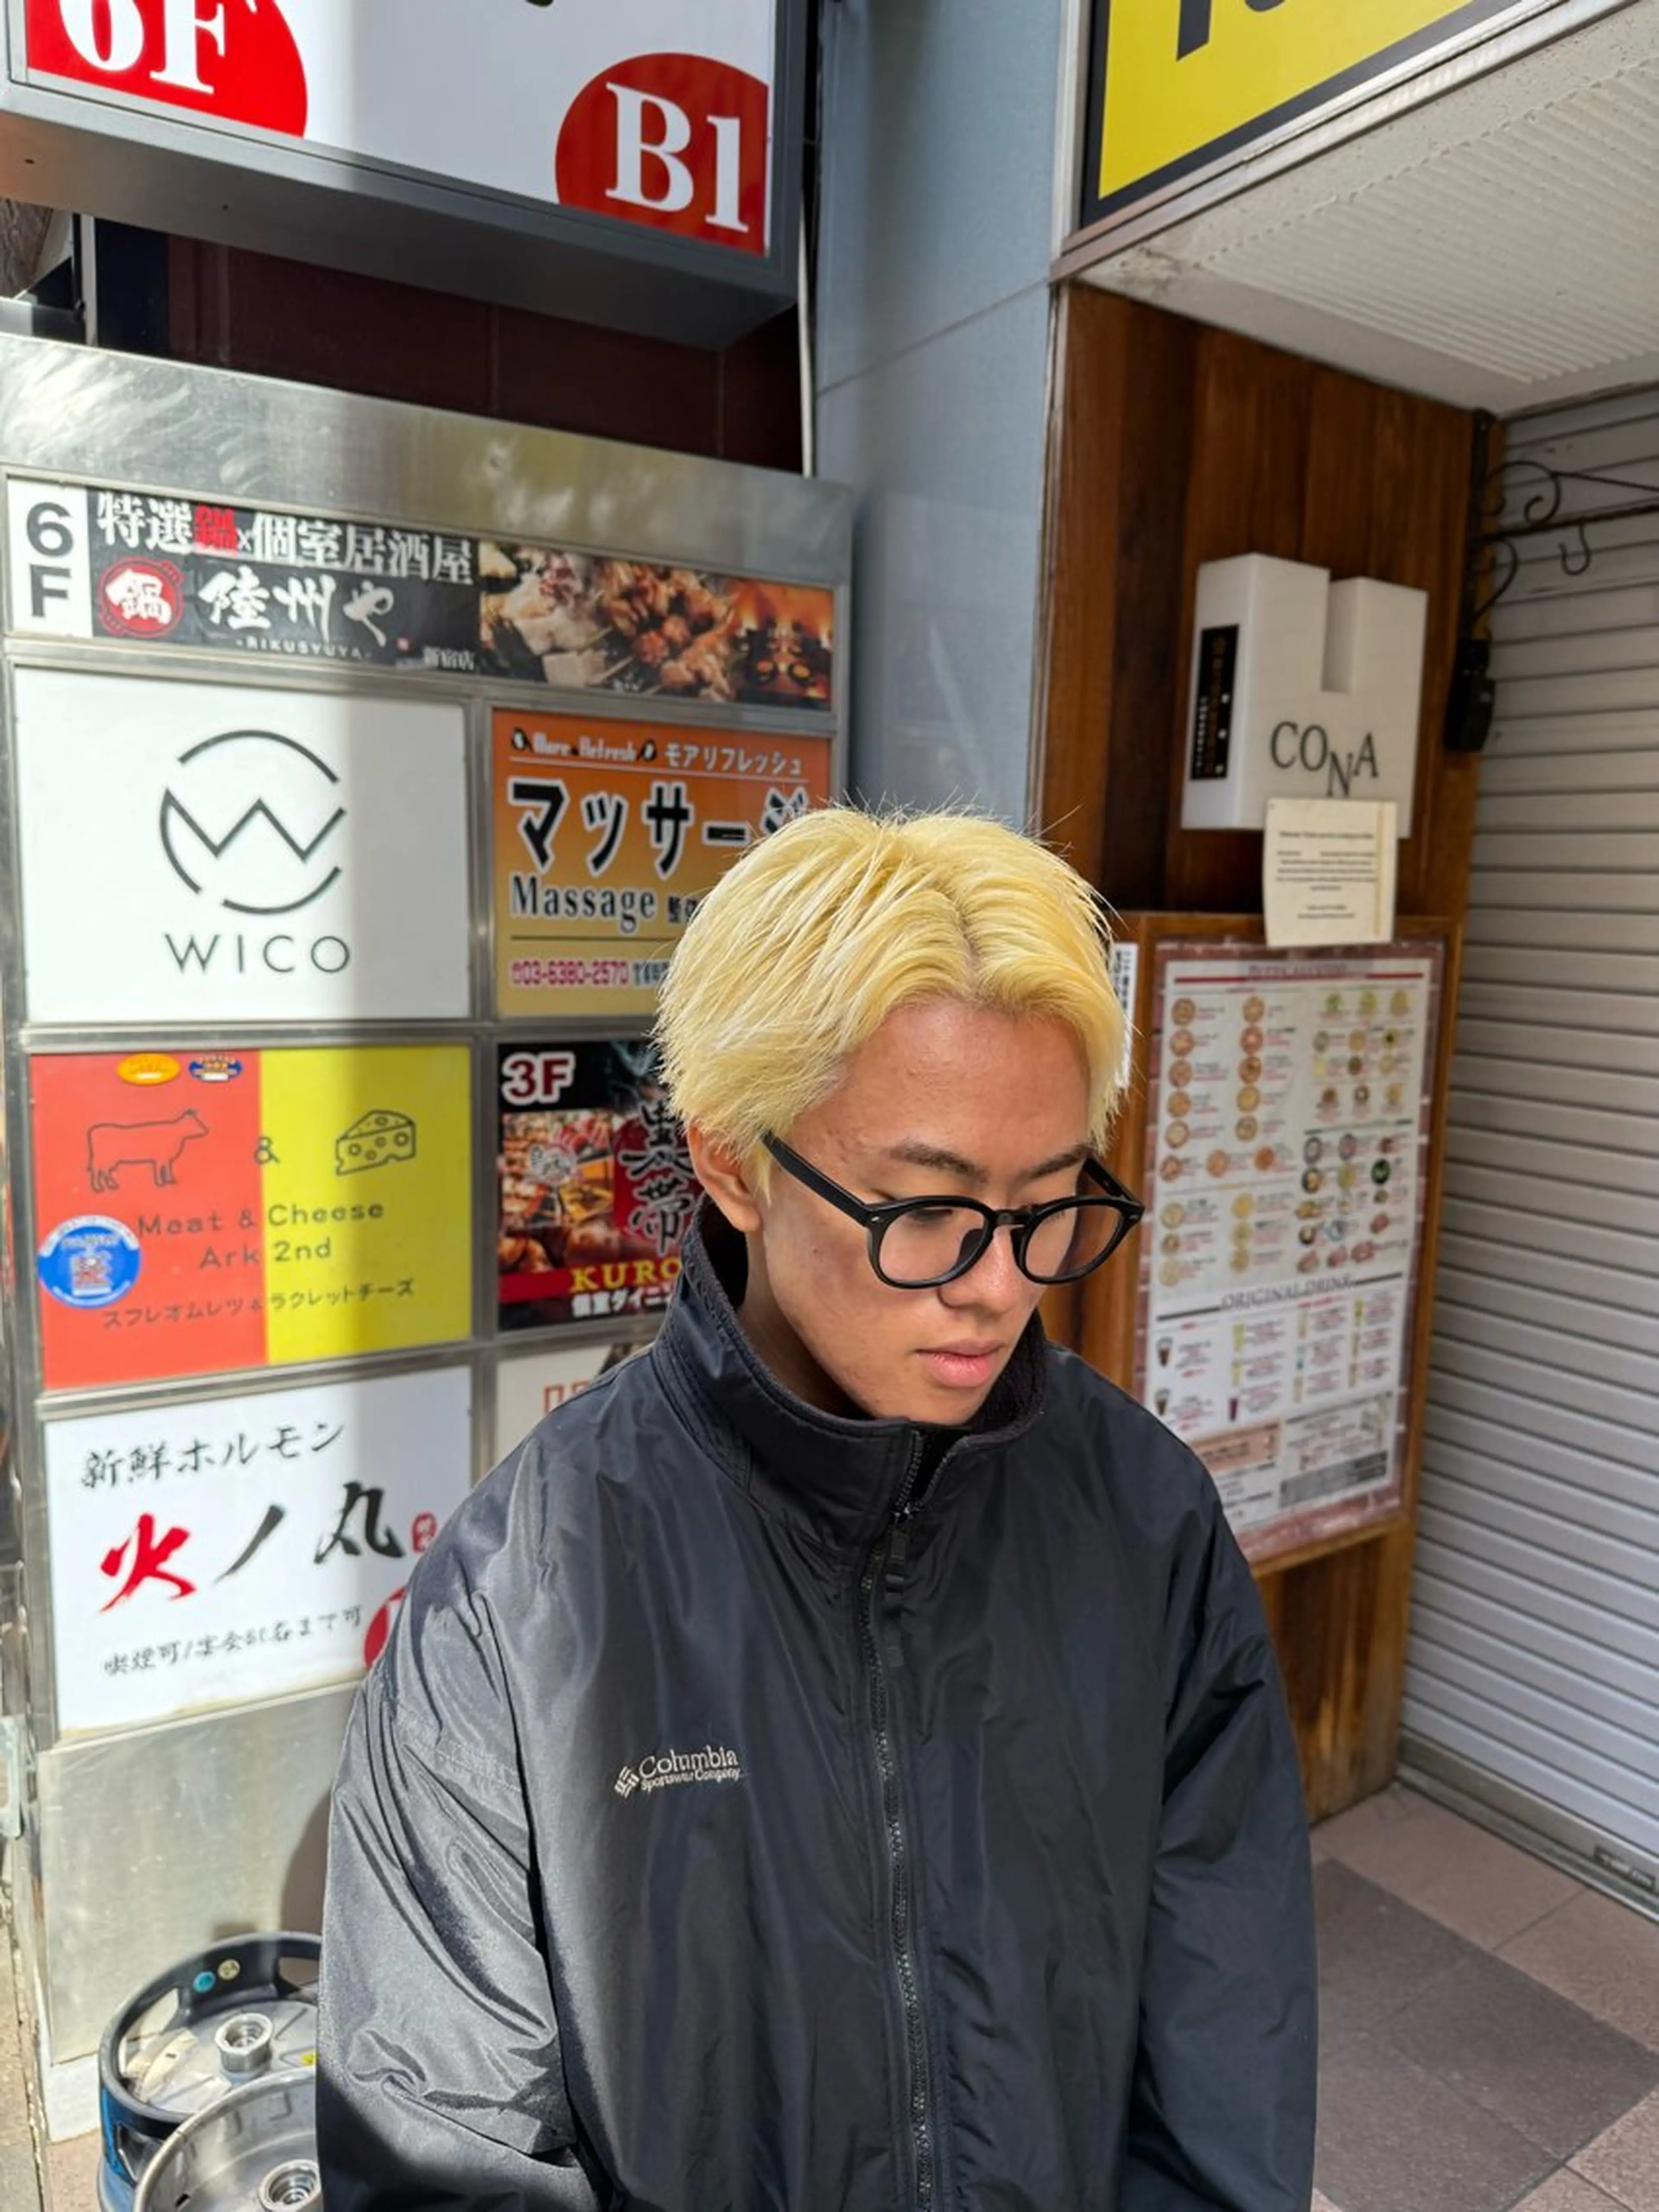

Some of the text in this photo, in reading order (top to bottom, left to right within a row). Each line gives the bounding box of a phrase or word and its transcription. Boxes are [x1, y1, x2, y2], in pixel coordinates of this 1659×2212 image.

[606, 81, 750, 234] B1
[664, 741, 802, 776] モアリフレッシュ
[1270, 719, 1380, 798] CONA
[511, 874, 655, 933] Massage
[163, 933, 350, 973] WICO
[505, 1054, 573, 1103] 3F
[253, 1135, 280, 1165] &
[199, 1238, 333, 1269] Ark 2nd
[81, 1420, 346, 1490] 新鮮ホルモン
[96, 1480, 406, 1614] 火ノ丸
[639, 1744, 739, 1779] Columbia
